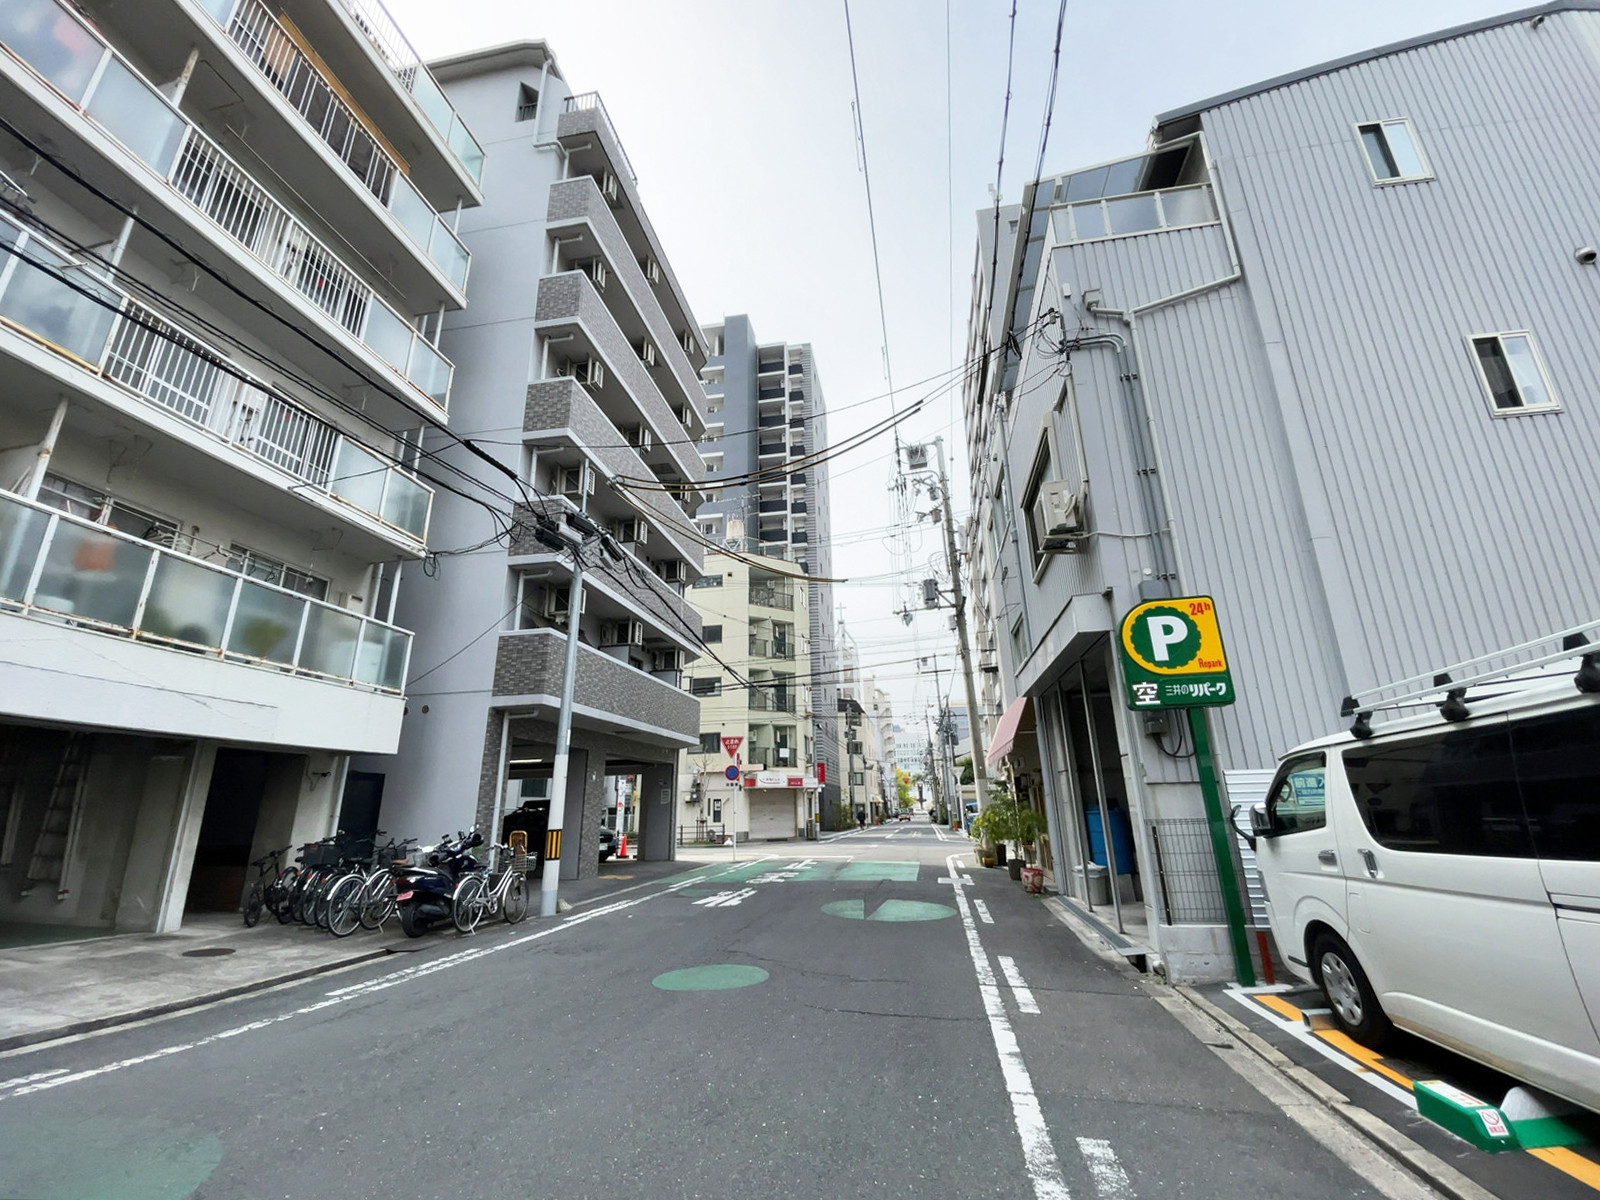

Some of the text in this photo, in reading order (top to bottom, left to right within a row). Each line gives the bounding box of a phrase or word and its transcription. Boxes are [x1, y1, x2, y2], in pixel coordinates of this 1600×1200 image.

[1147, 615, 1188, 662] P
[1198, 658, 1223, 669] Repark
[1132, 682, 1161, 705] 空
[1165, 682, 1226, 697] 三井のリパーク
